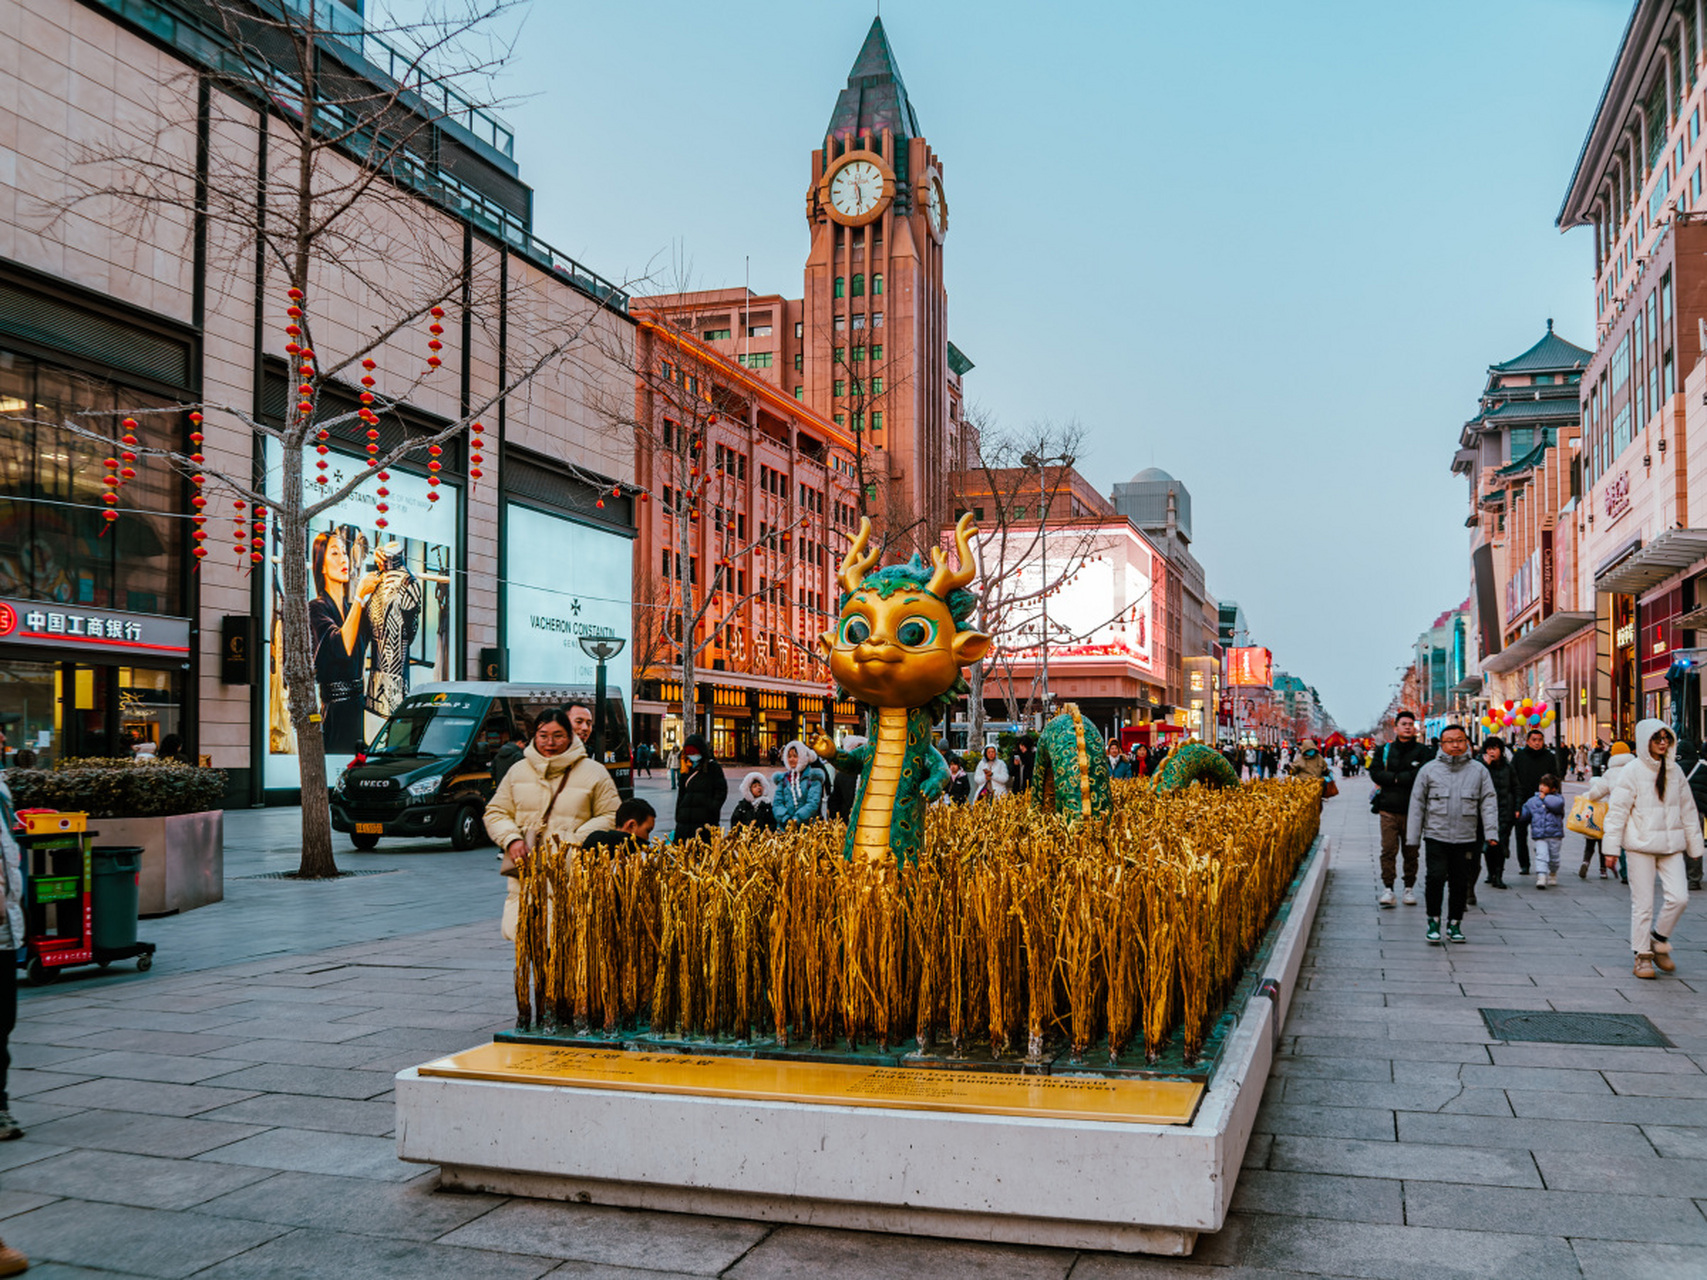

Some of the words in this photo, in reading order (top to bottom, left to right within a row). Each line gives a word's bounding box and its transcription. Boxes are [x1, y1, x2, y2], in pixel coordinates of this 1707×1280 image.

[26, 610, 142, 641] 中国工商银行
[530, 615, 572, 634] VACHERON
[573, 622, 615, 637] CONSTANTIN
[359, 780, 390, 788] IVECO
